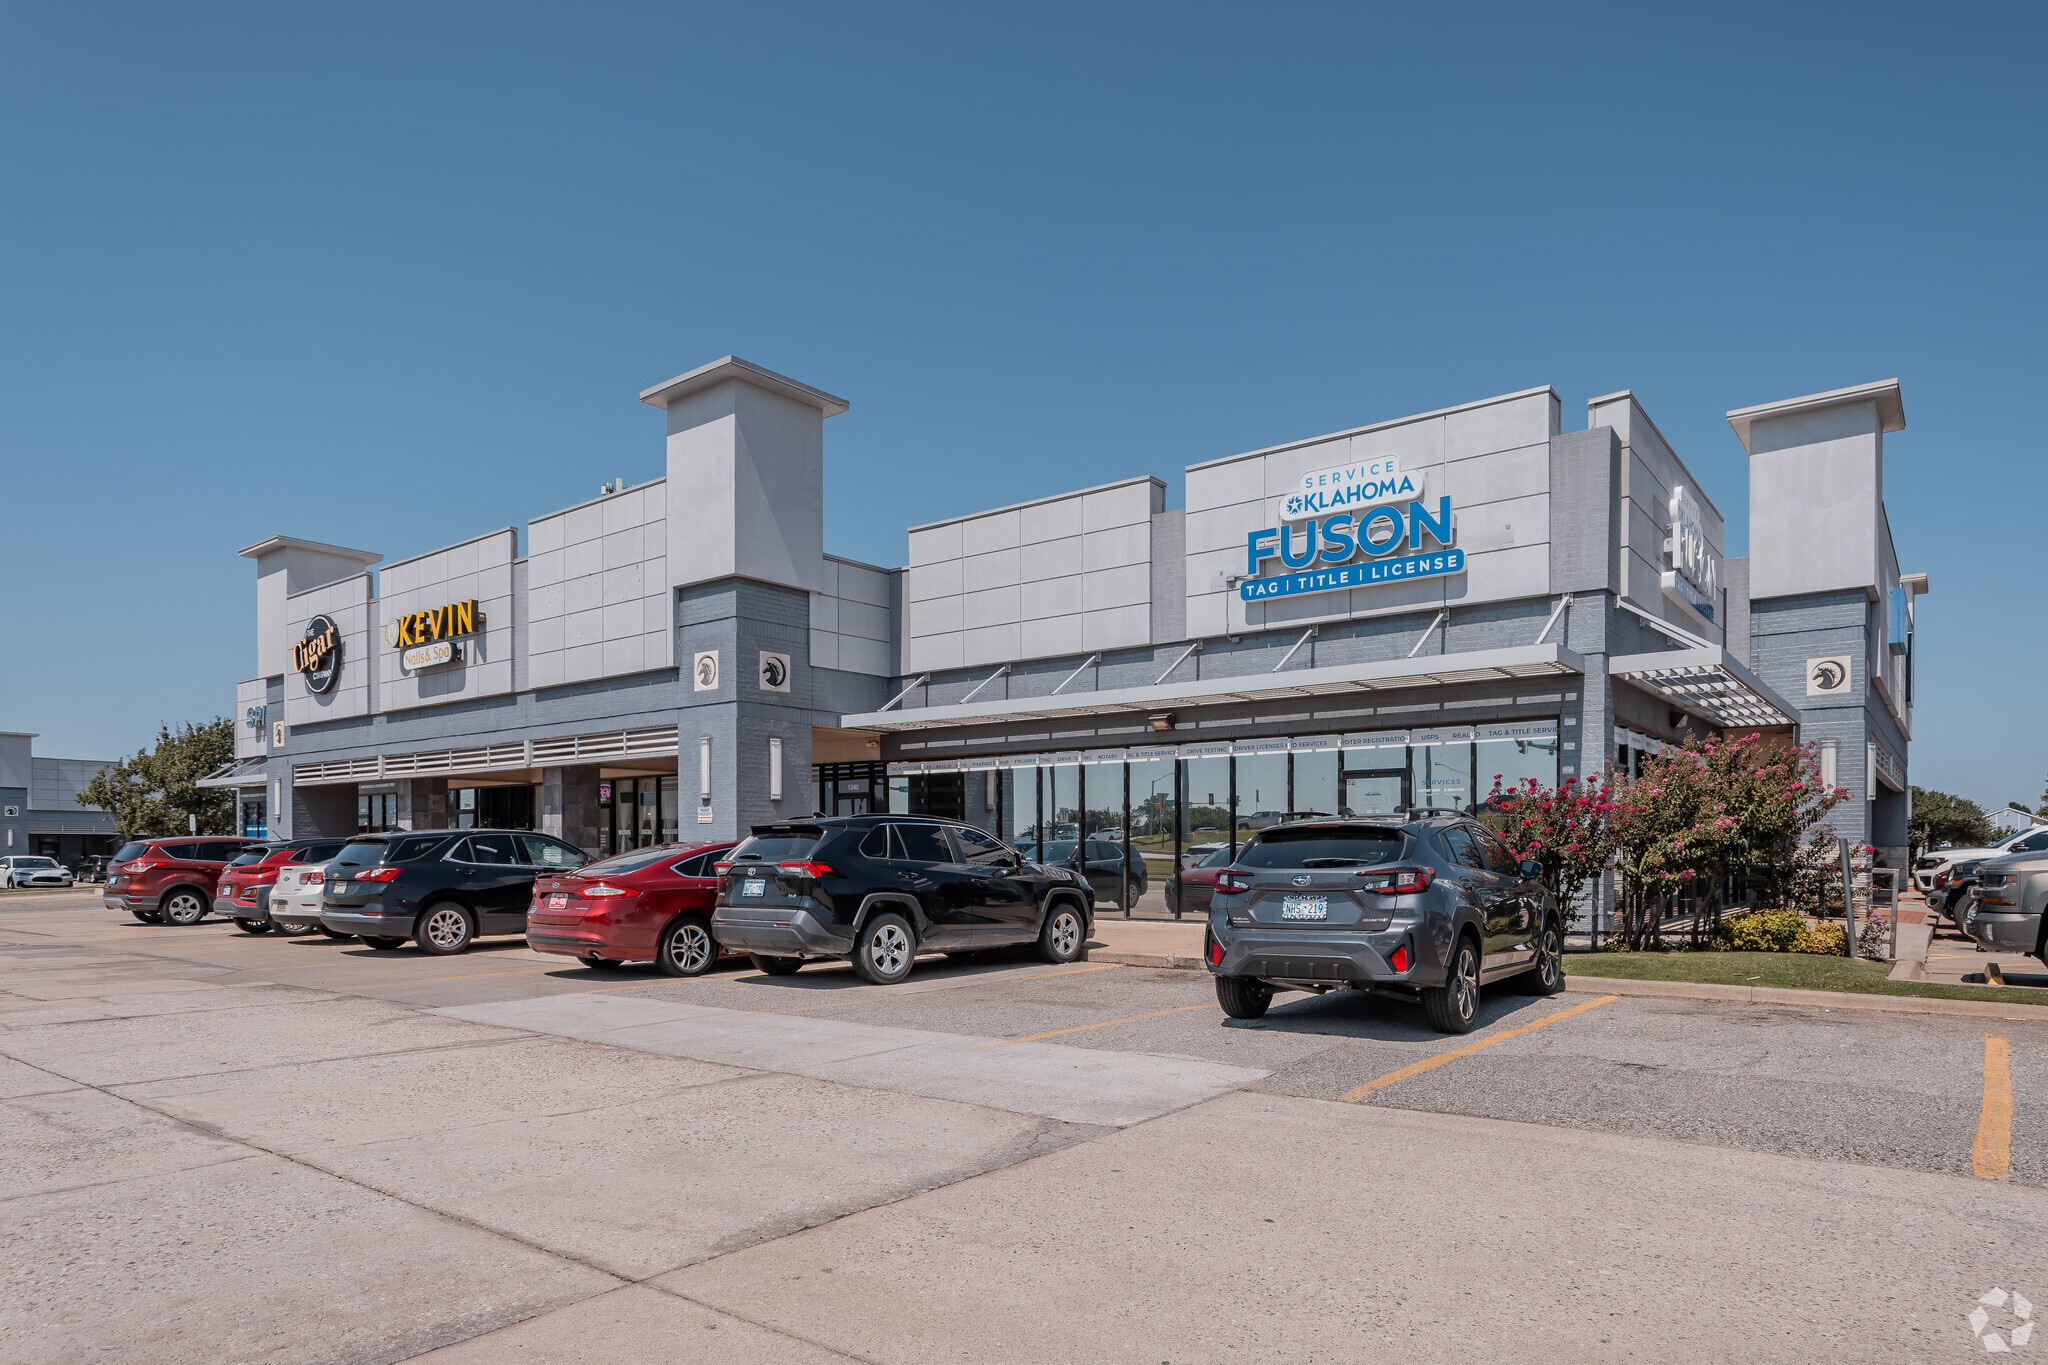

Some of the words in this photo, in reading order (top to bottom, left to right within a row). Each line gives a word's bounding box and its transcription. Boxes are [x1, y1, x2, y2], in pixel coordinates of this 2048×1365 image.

[1305, 460, 1395, 489] SERVICE
[1247, 495, 1451, 576] FUSON
[1246, 582, 1278, 597] TAG
[1298, 572, 1350, 590] TITLE
[1371, 555, 1458, 579] LICENSE
[399, 599, 473, 647] KEVIN
[292, 626, 334, 674] Cigar
[433, 646, 450, 660] Spa
[1205, 746, 1227, 754] TESTING
[1234, 744, 1255, 752] DRIVER
[1256, 742, 1284, 750] LICENSES
[1284, 741, 1298, 749] AD
[1299, 740, 1328, 748] SERVICES
[1421, 733, 1440, 741] USPS
[1453, 730, 1470, 739] REAL
[1488, 729, 1503, 737] TAG
[1505, 728, 1510, 736] &
[1512, 727, 1531, 736] TITLE
[1285, 903, 1301, 915] NHS
[1308, 903, 1324, 914] 219
